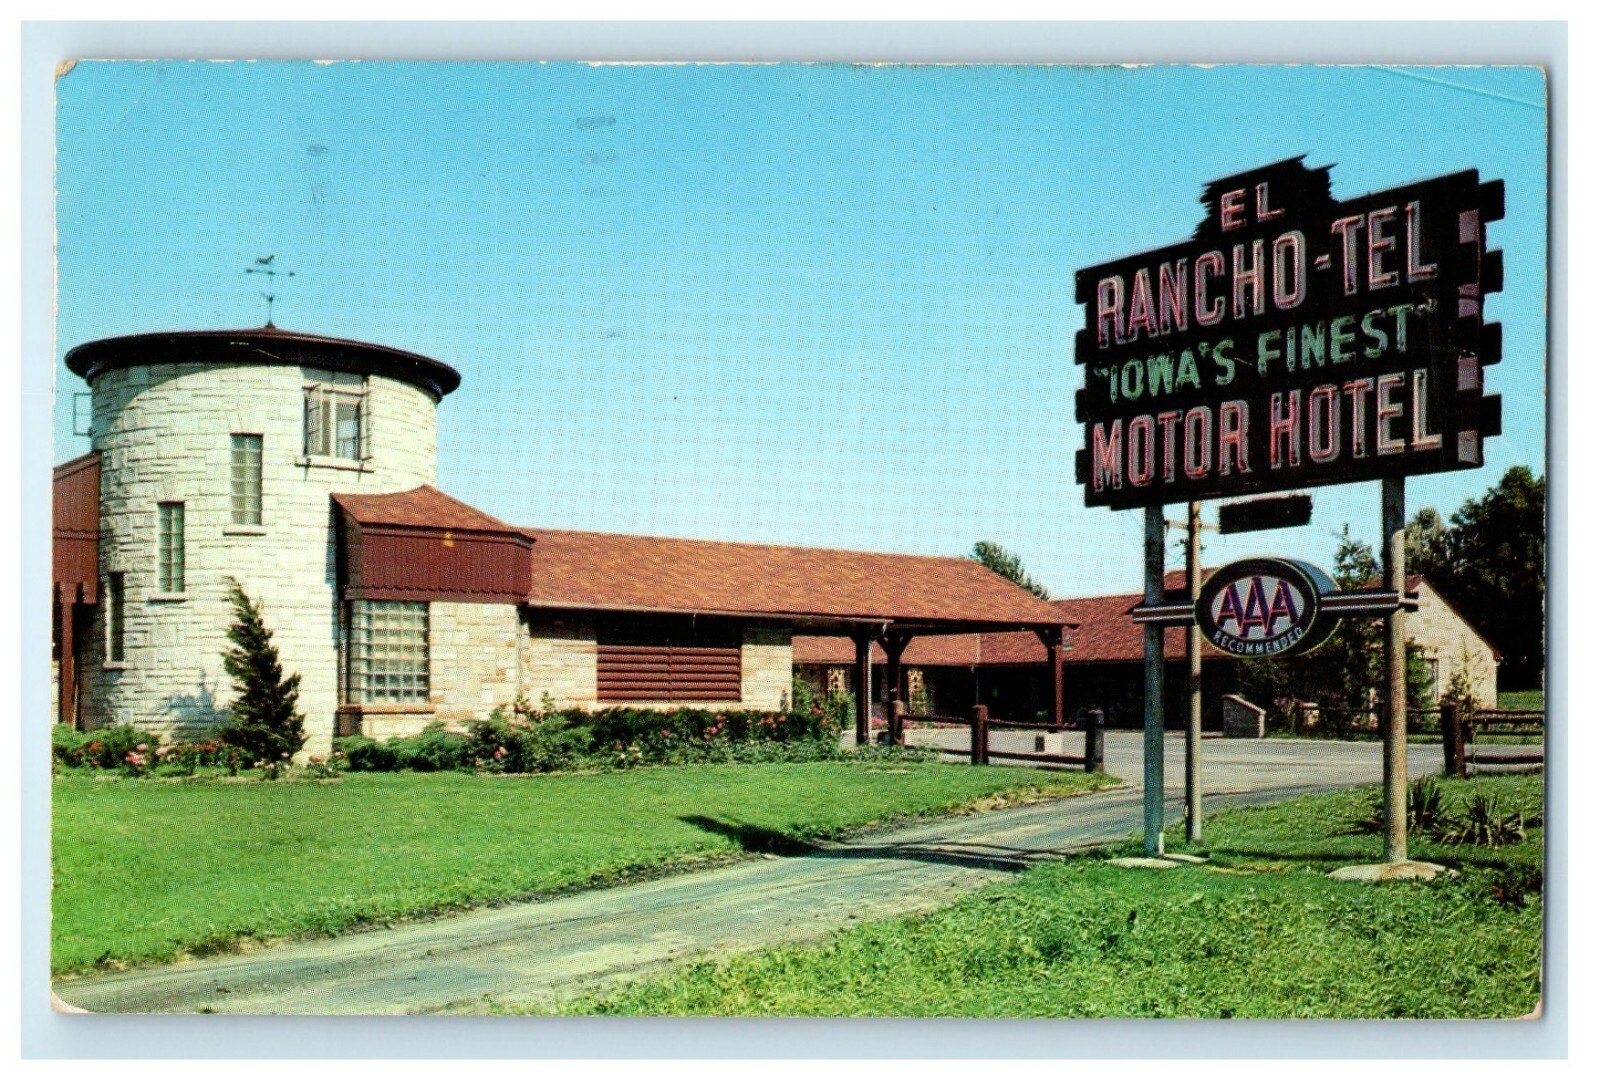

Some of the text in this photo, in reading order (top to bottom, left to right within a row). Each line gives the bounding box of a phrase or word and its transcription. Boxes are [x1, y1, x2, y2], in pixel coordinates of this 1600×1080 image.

[1220, 182, 1286, 232] EL
[1097, 200, 1438, 349] RANCHO-TEL
[1093, 369, 1443, 492] MOTOR HOTEL
[1215, 576, 1300, 638] AAA
[1213, 627, 1304, 654] RECOMMENDED
